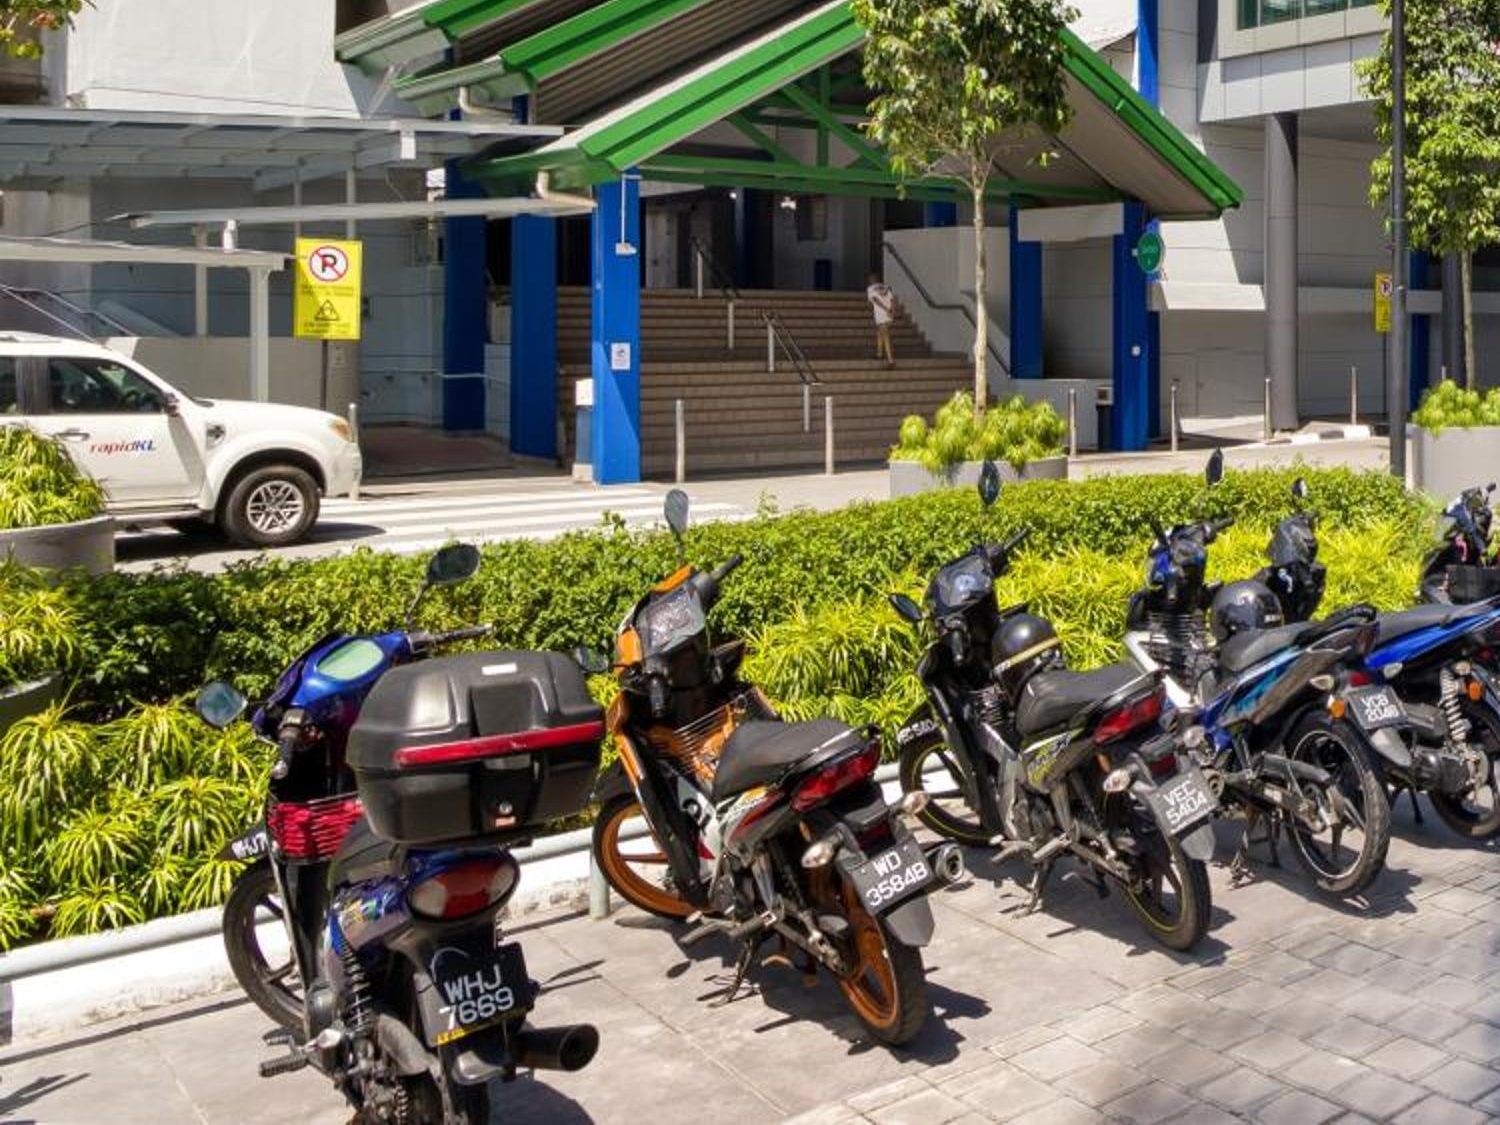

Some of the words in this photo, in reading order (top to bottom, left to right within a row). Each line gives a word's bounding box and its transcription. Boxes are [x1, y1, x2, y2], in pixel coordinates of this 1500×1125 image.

[90, 440, 156, 455] rapidKL
[1163, 779, 1197, 806] VEC
[1165, 790, 1208, 825] 5404
[872, 851, 902, 878] WD
[443, 964, 502, 1004] WHJ
[438, 986, 515, 1031] 7669
